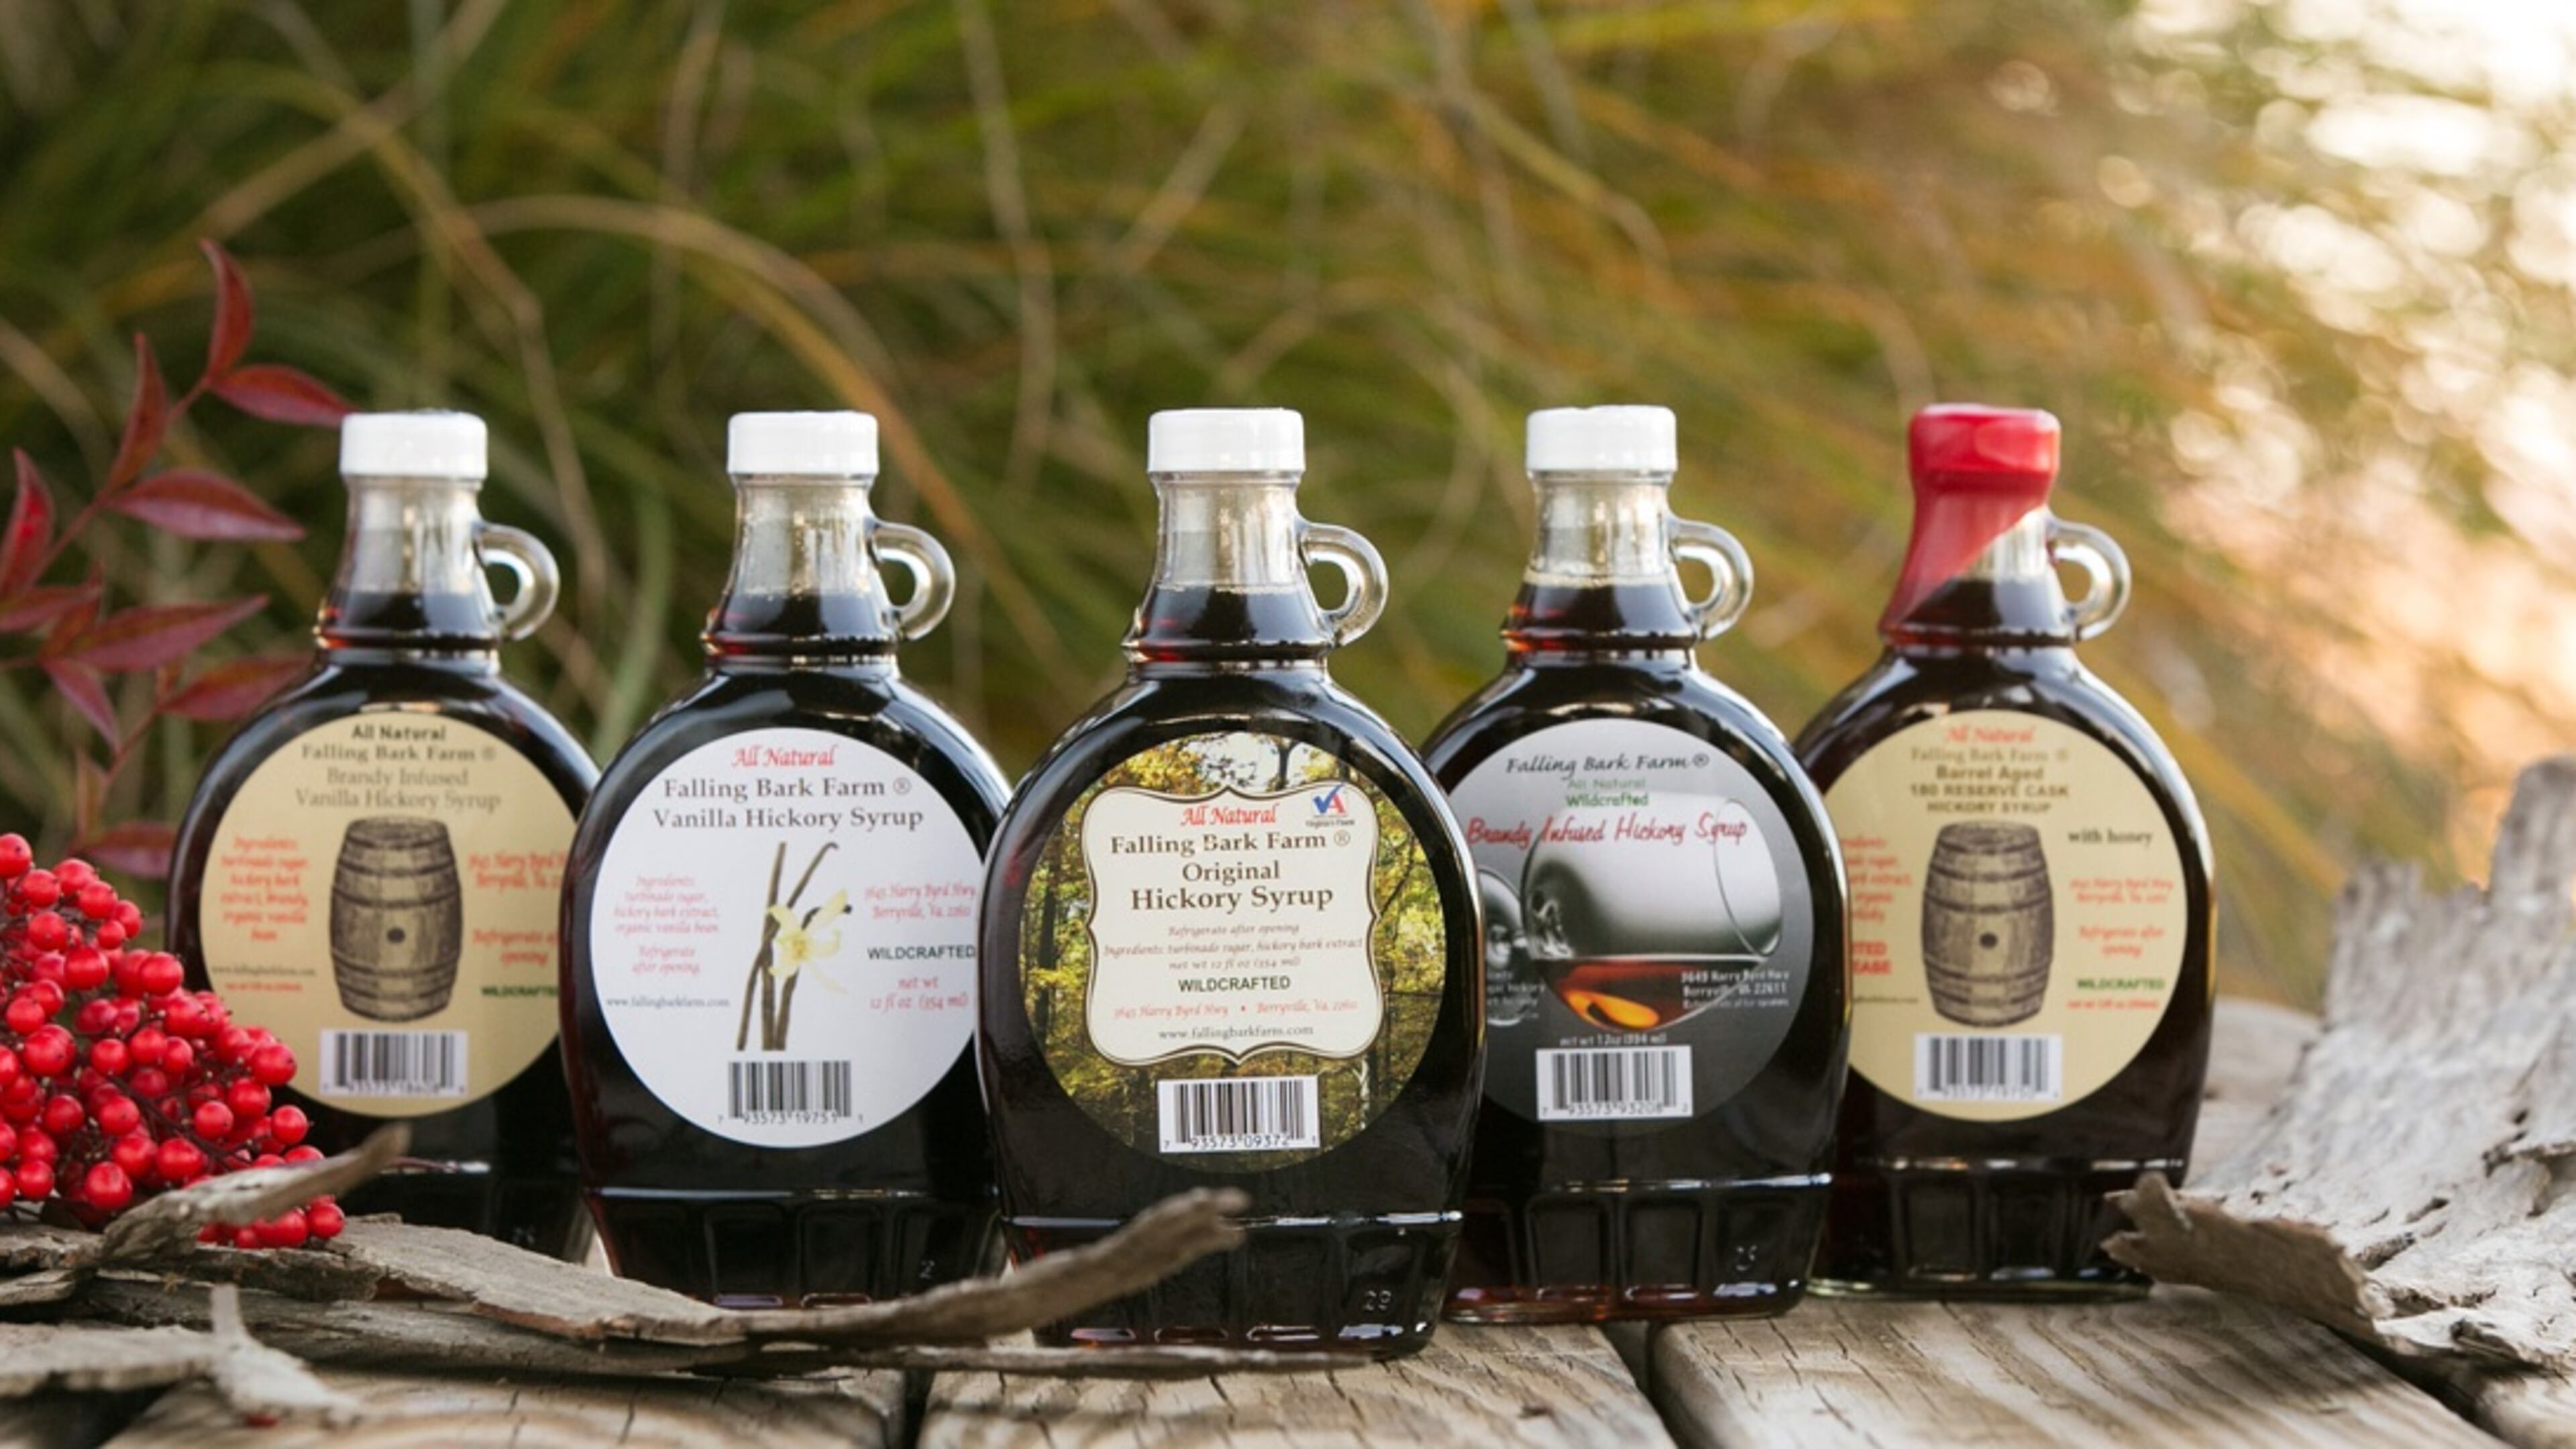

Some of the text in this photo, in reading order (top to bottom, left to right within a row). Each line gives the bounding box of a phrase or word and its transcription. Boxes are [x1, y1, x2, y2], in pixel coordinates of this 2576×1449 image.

[352, 724, 446, 740] All Natural
[1947, 724, 2035, 742] All Natural
[302, 744, 368, 761] Falling
[376, 745, 419, 760] Bark
[427, 746, 476, 760] Farm
[732, 745, 838, 767] All Natural
[1912, 747, 2048, 763] Falling Bark Farm
[1506, 756, 1576, 780] Falling
[1583, 754, 1629, 771] Bark
[1936, 765, 2044, 783] Barrel Aged
[327, 767, 469, 788] Brandy Infused
[1593, 777, 1646, 790] Natural
[664, 779, 748, 802] Falling
[757, 777, 814, 797] Bark
[823, 777, 885, 796] Farm
[1943, 784, 2017, 797] RESERVE
[2025, 784, 2069, 797] CASK
[295, 788, 503, 813] Vanilla Hickory Syrup
[1565, 793, 1649, 808] Wildcrafted
[1927, 802, 2051, 814] HICKORY SYRUP
[653, 808, 924, 832] Vanilla Hickory Syrup
[1180, 803, 1279, 826] All Natural
[1466, 812, 1748, 850] Brandy Infused Hickory Syrup
[2068, 828, 2153, 848] with honey
[1111, 836, 1195, 857] Falling
[1203, 833, 1258, 851] Bark
[1267, 832, 1326, 849] Farm
[1182, 860, 1281, 887] Original
[1132, 885, 1334, 914] Hickory Syrup
[1168, 923, 1300, 938] Refrigerate after opening
[867, 945, 976, 960] WILDCRAFTED
[1256, 940, 1297, 953] hickory
[1299, 938, 1323, 951] bark
[898, 976, 917, 989] net
[1178, 975, 1291, 993] WILDCRAFTED
[1159, 1025, 1314, 1042] www.fallingbarkfarm.com
